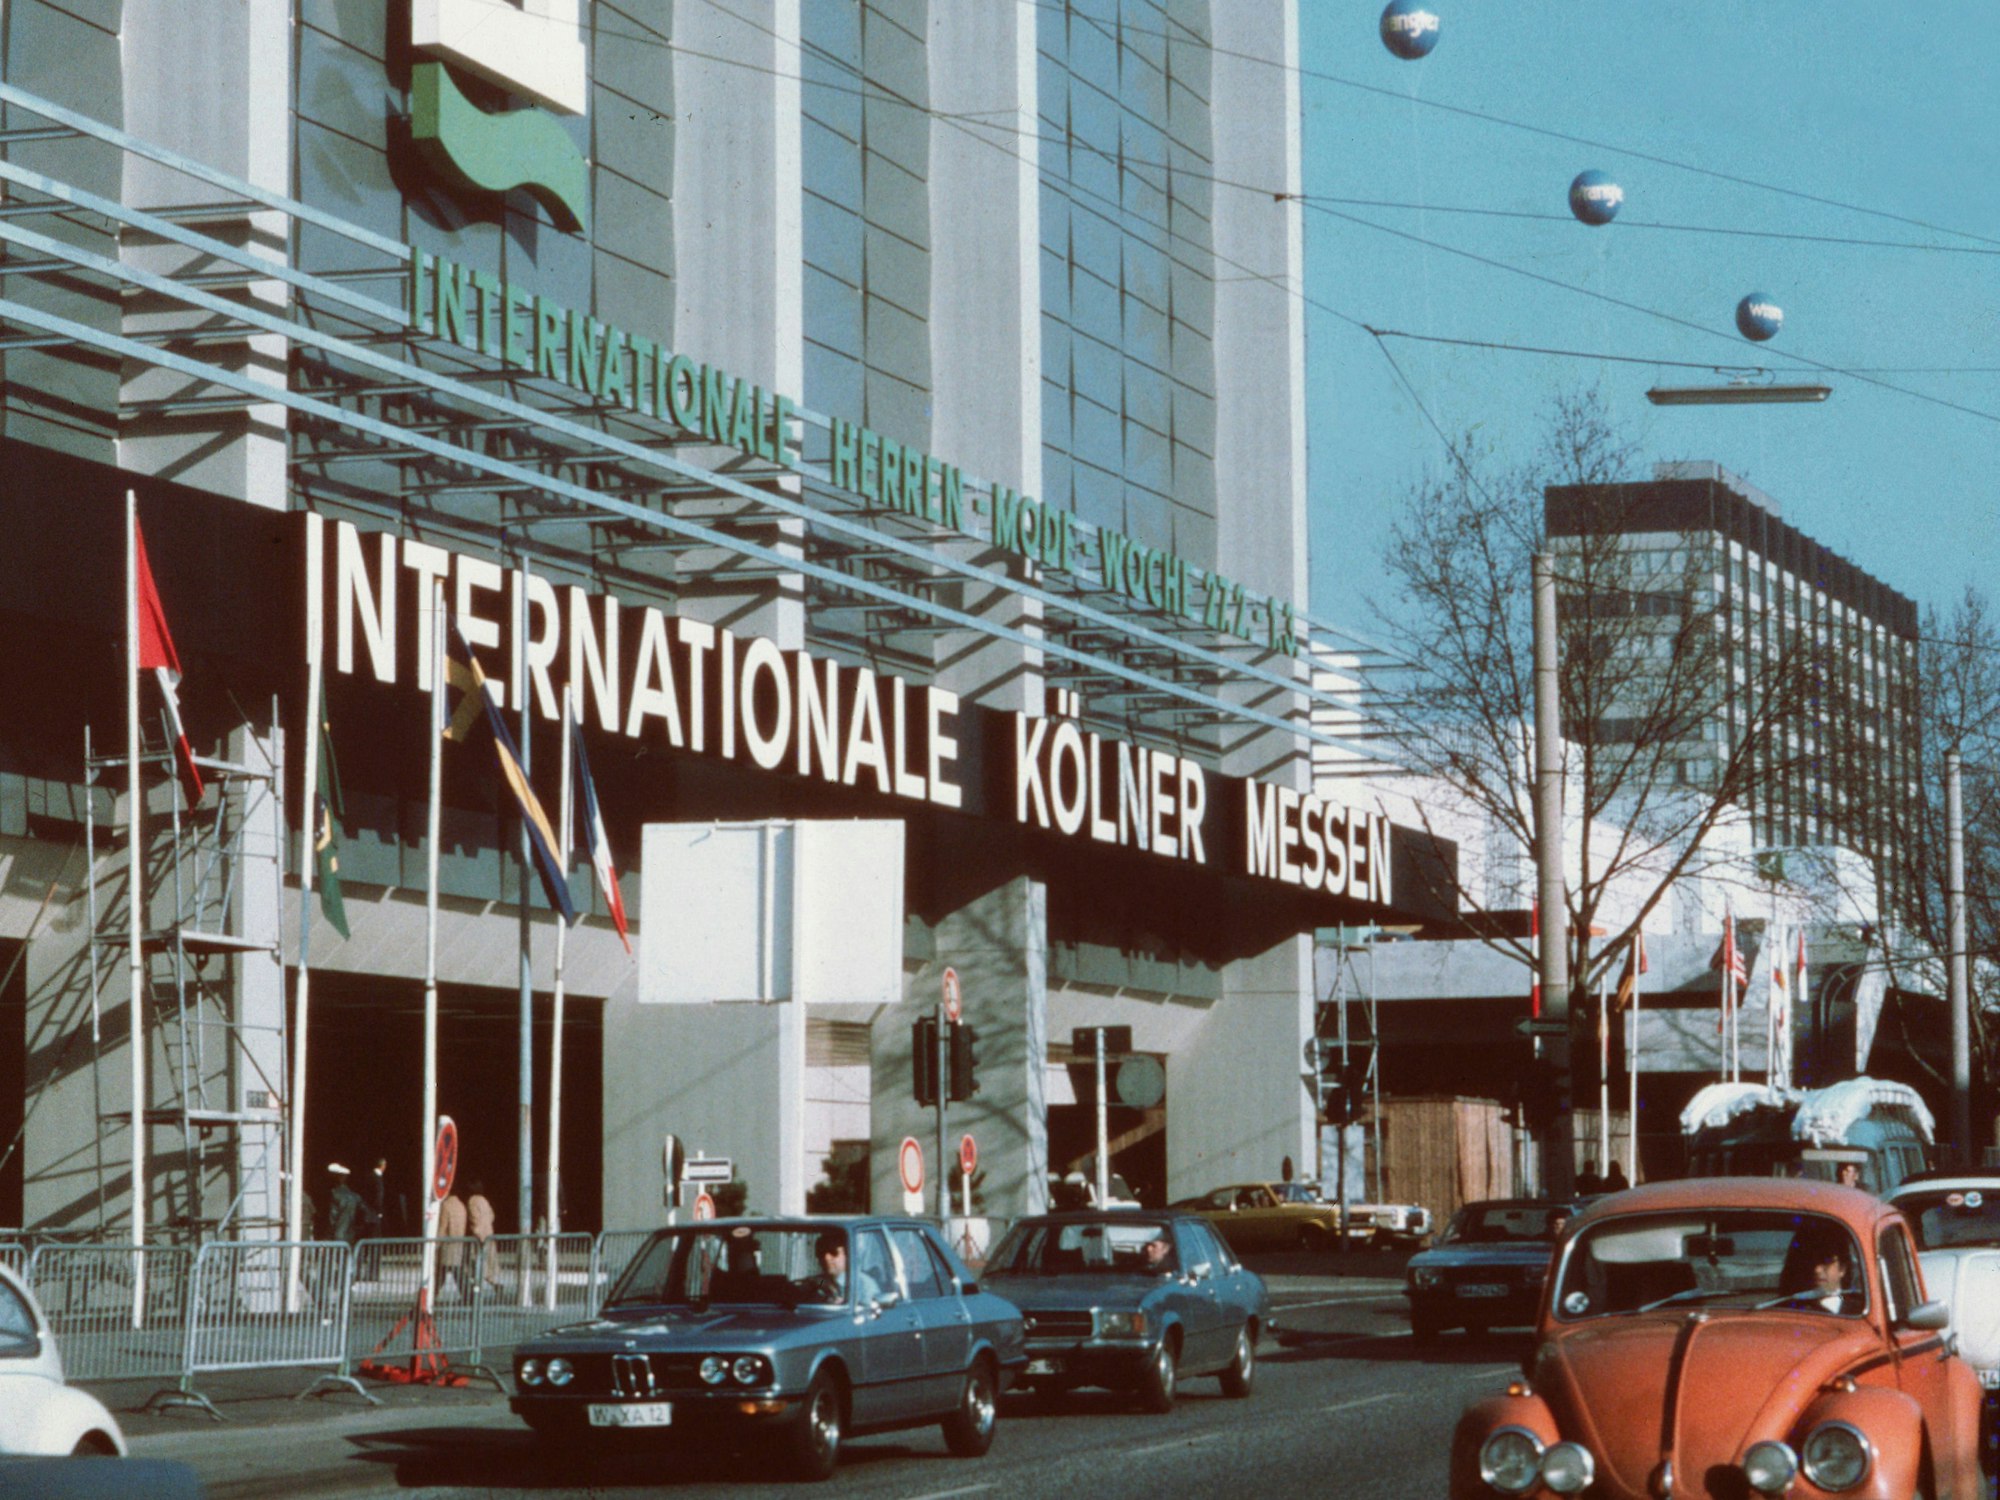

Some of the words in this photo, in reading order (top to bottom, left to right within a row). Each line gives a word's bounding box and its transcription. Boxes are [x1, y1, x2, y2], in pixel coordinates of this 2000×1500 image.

[410, 246, 794, 467] INTERNATIONALE
[306, 511, 962, 808] INTERNATIONALE
[1016, 687, 1206, 864] KÖLNER
[1246, 776, 1392, 906] MESSEN
